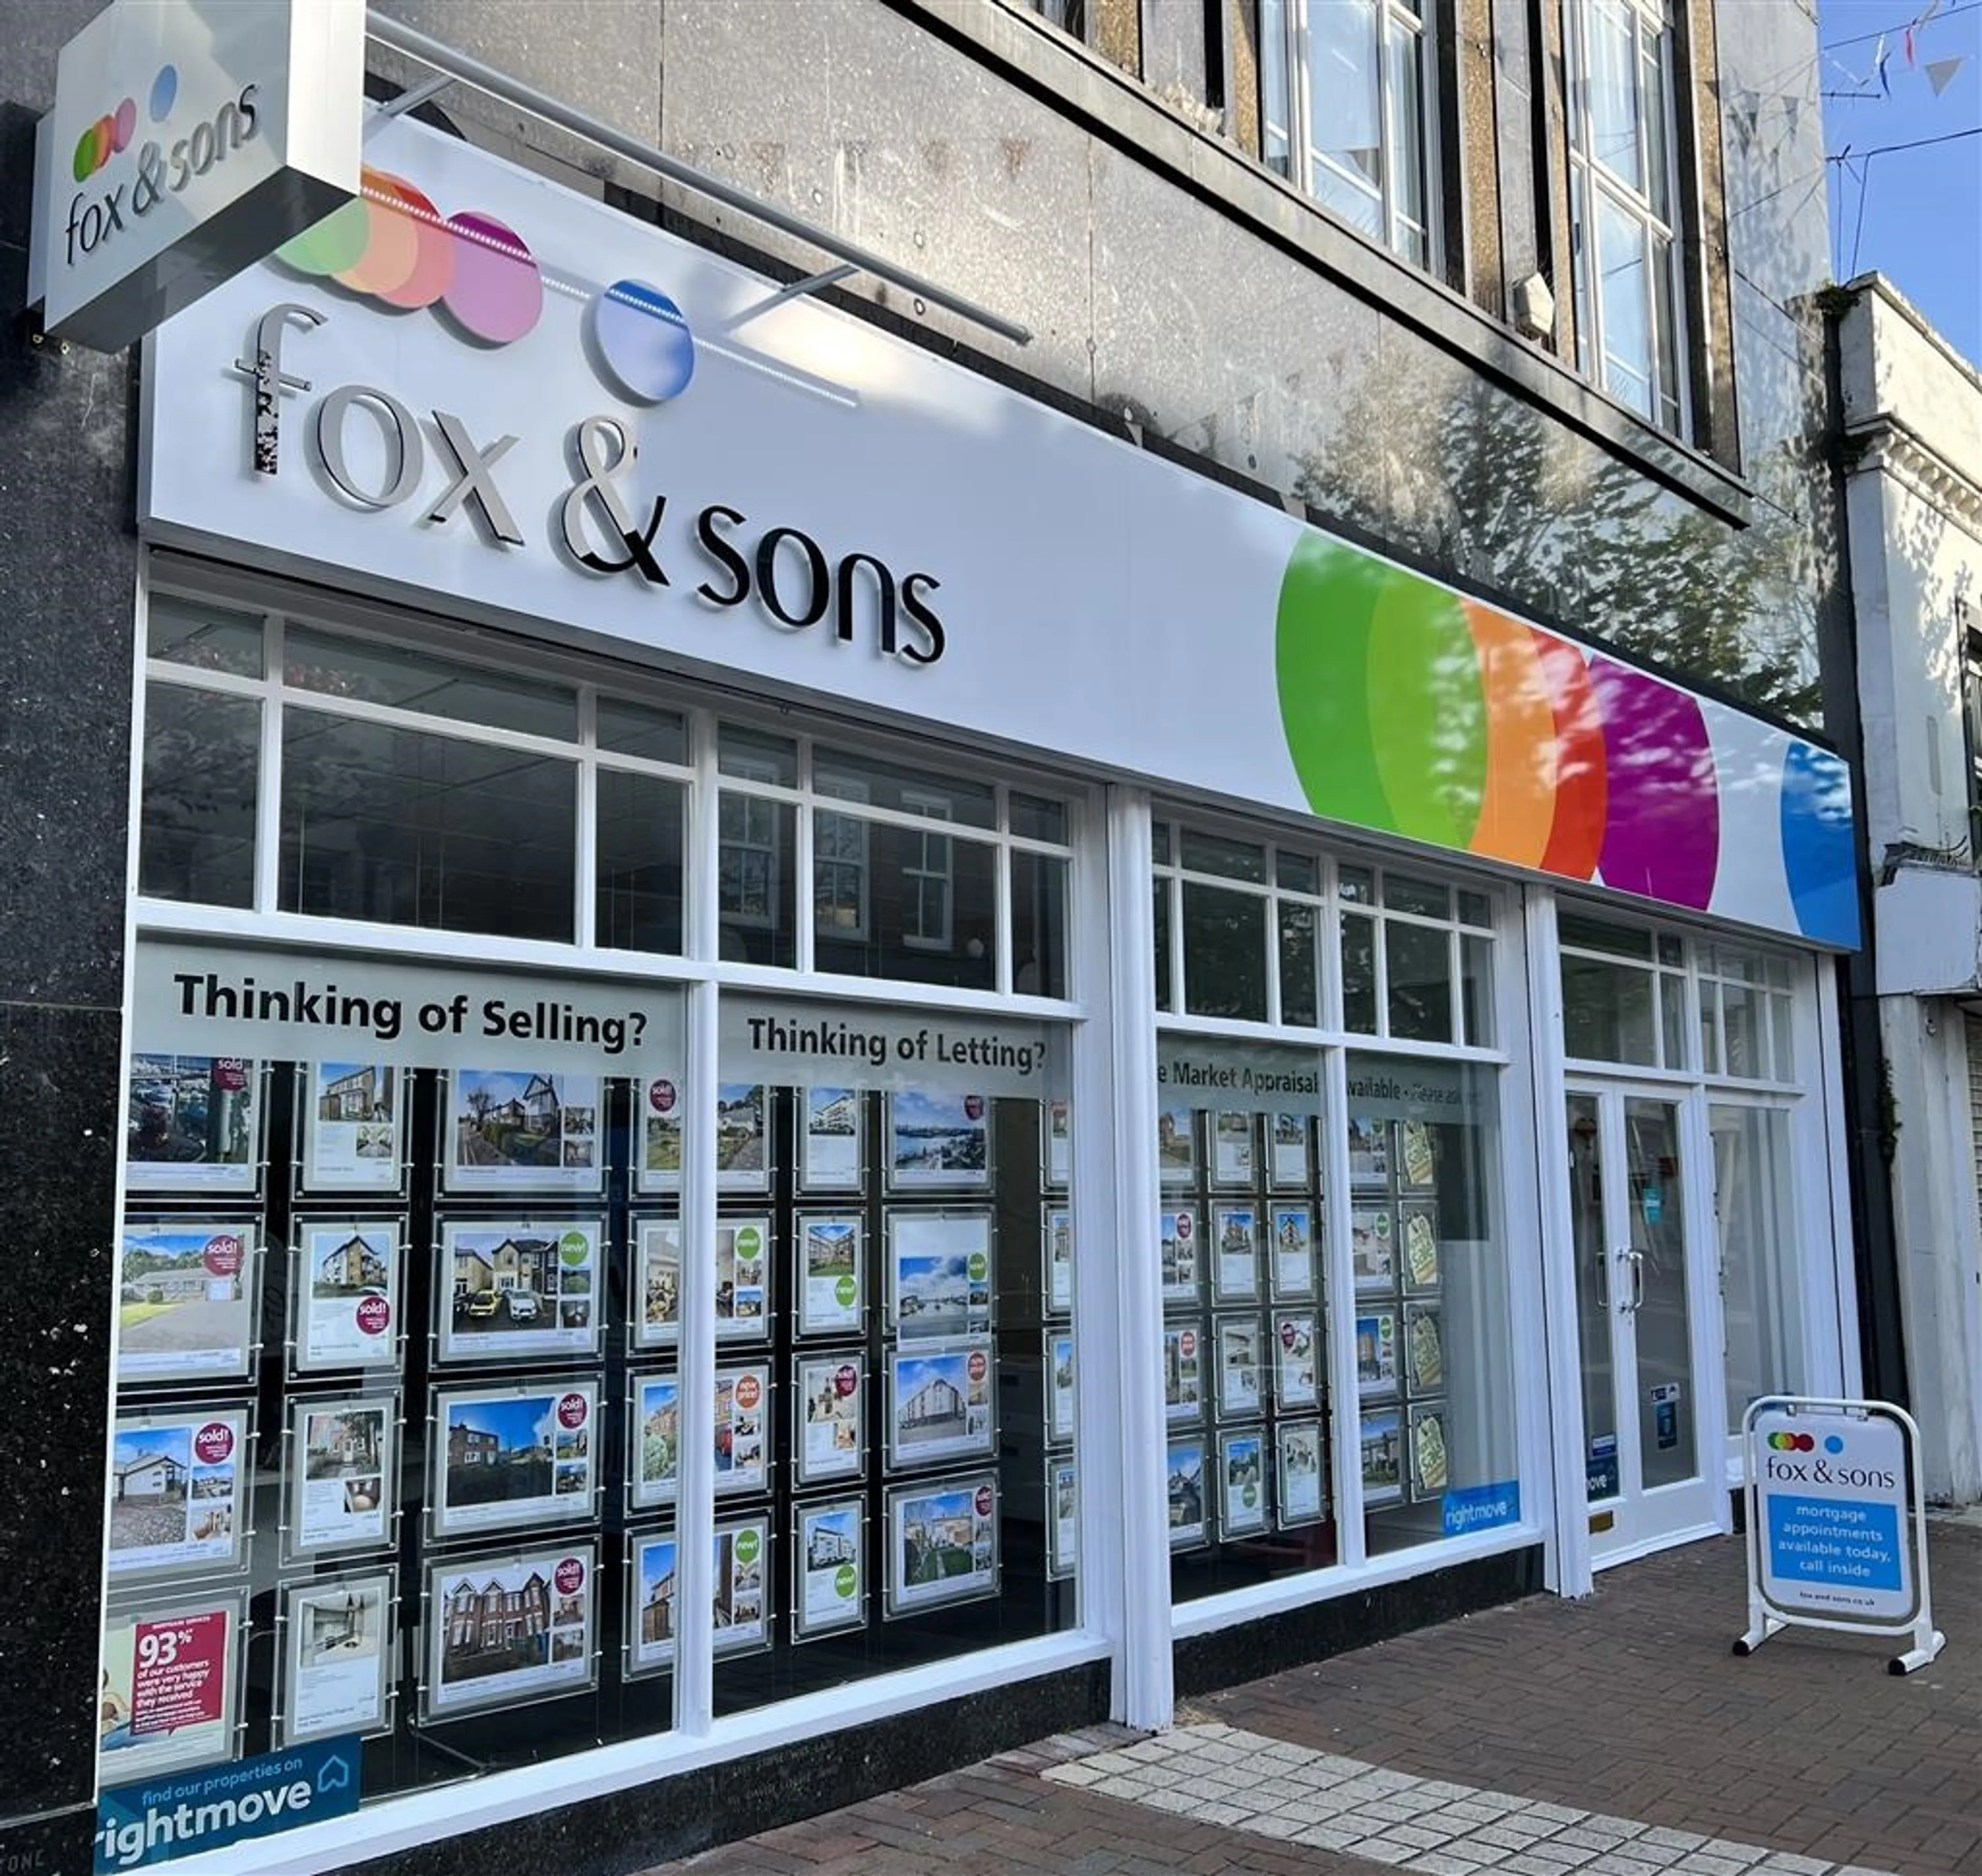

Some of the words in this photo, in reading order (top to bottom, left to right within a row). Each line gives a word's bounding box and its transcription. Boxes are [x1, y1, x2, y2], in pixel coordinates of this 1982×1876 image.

[66, 184, 124, 264] fox
[133, 141, 167, 216] &
[169, 84, 258, 192] sons
[234, 303, 525, 546] fox
[560, 415, 670, 586] &
[696, 505, 945, 663] sons
[174, 974, 401, 1038] Thinking
[418, 996, 468, 1033] of
[483, 1000, 647, 1054] Selling?
[748, 1018, 886, 1066] Thinking
[897, 1029, 928, 1060] of
[938, 1034, 1045, 1075] Letting?
[1173, 1062, 1237, 1088] Market
[1242, 1068, 1319, 1095] Appraisal
[1346, 1076, 1400, 1101] vailable
[207, 1241, 237, 1254] sold!
[359, 1303, 386, 1315] sold!
[199, 1428, 228, 1443] sold!
[1766, 1456, 1809, 1482] fox
[1813, 1458, 1833, 1484] &
[1838, 1468, 1896, 1489] sons
[1446, 1501, 1507, 1531] rightmove
[1796, 1505, 1867, 1522] mortgage
[1779, 1540, 1842, 1555] available
[1783, 1523, 1884, 1542] appointments
[1799, 1560, 1823, 1572] call
[1828, 1561, 1872, 1577] inside
[142, 1786, 171, 1806] find
[174, 1783, 202, 1798] our
[204, 1762, 281, 1794] properties
[284, 1758, 302, 1772] on
